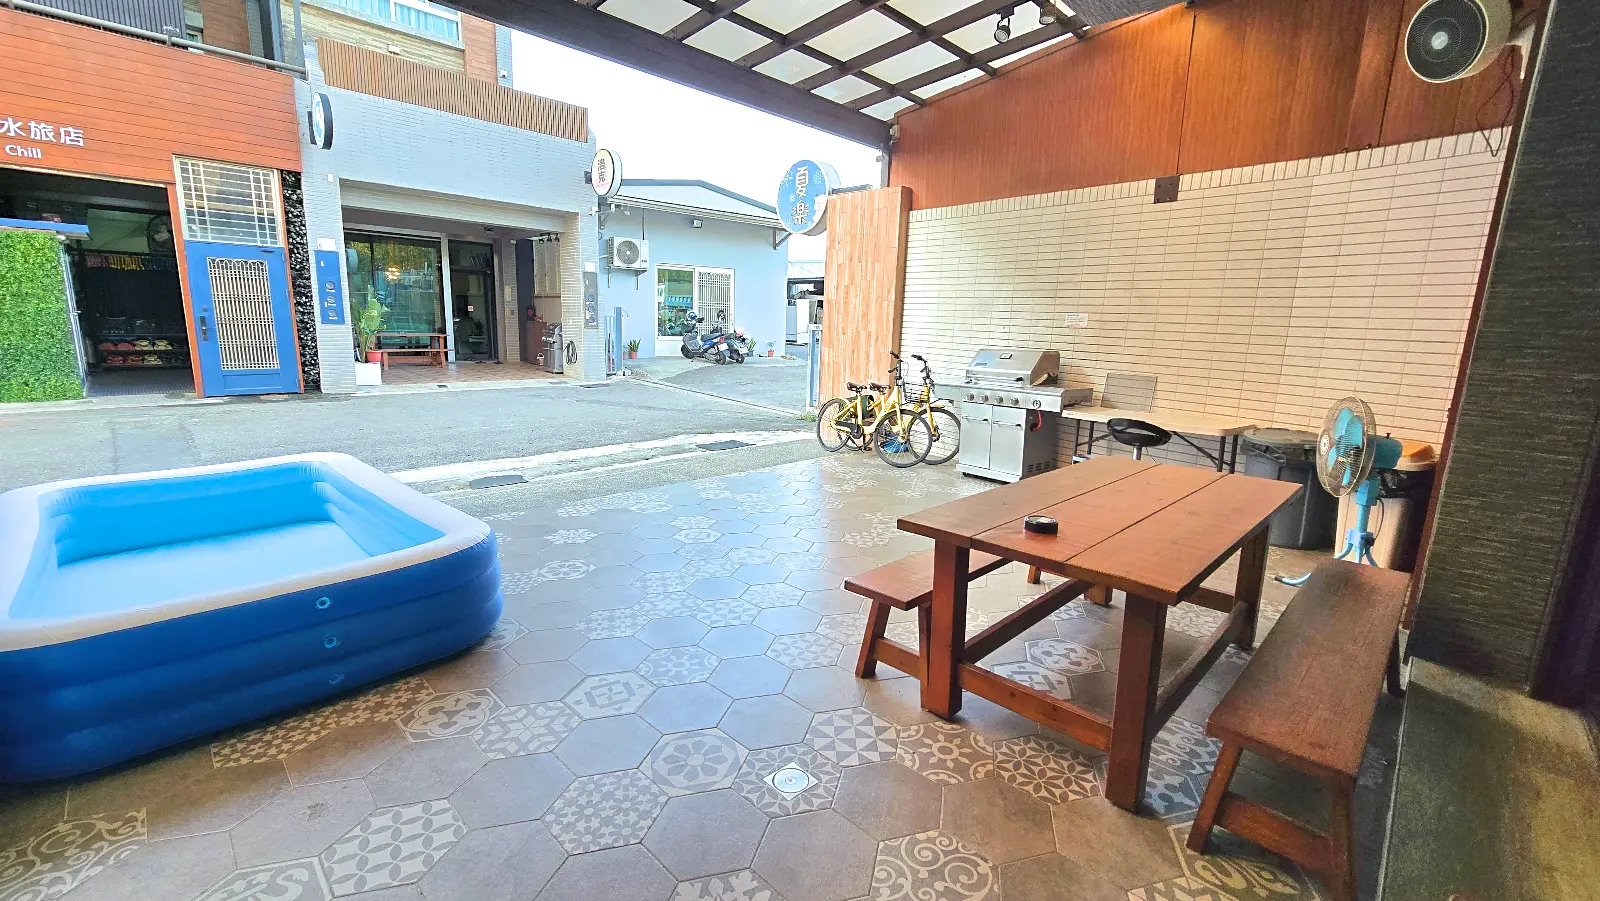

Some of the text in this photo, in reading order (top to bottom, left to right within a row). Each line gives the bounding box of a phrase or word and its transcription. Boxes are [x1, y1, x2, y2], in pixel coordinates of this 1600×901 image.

[0, 117, 84, 146] 水旅店
[5, 145, 42, 158] Chill
